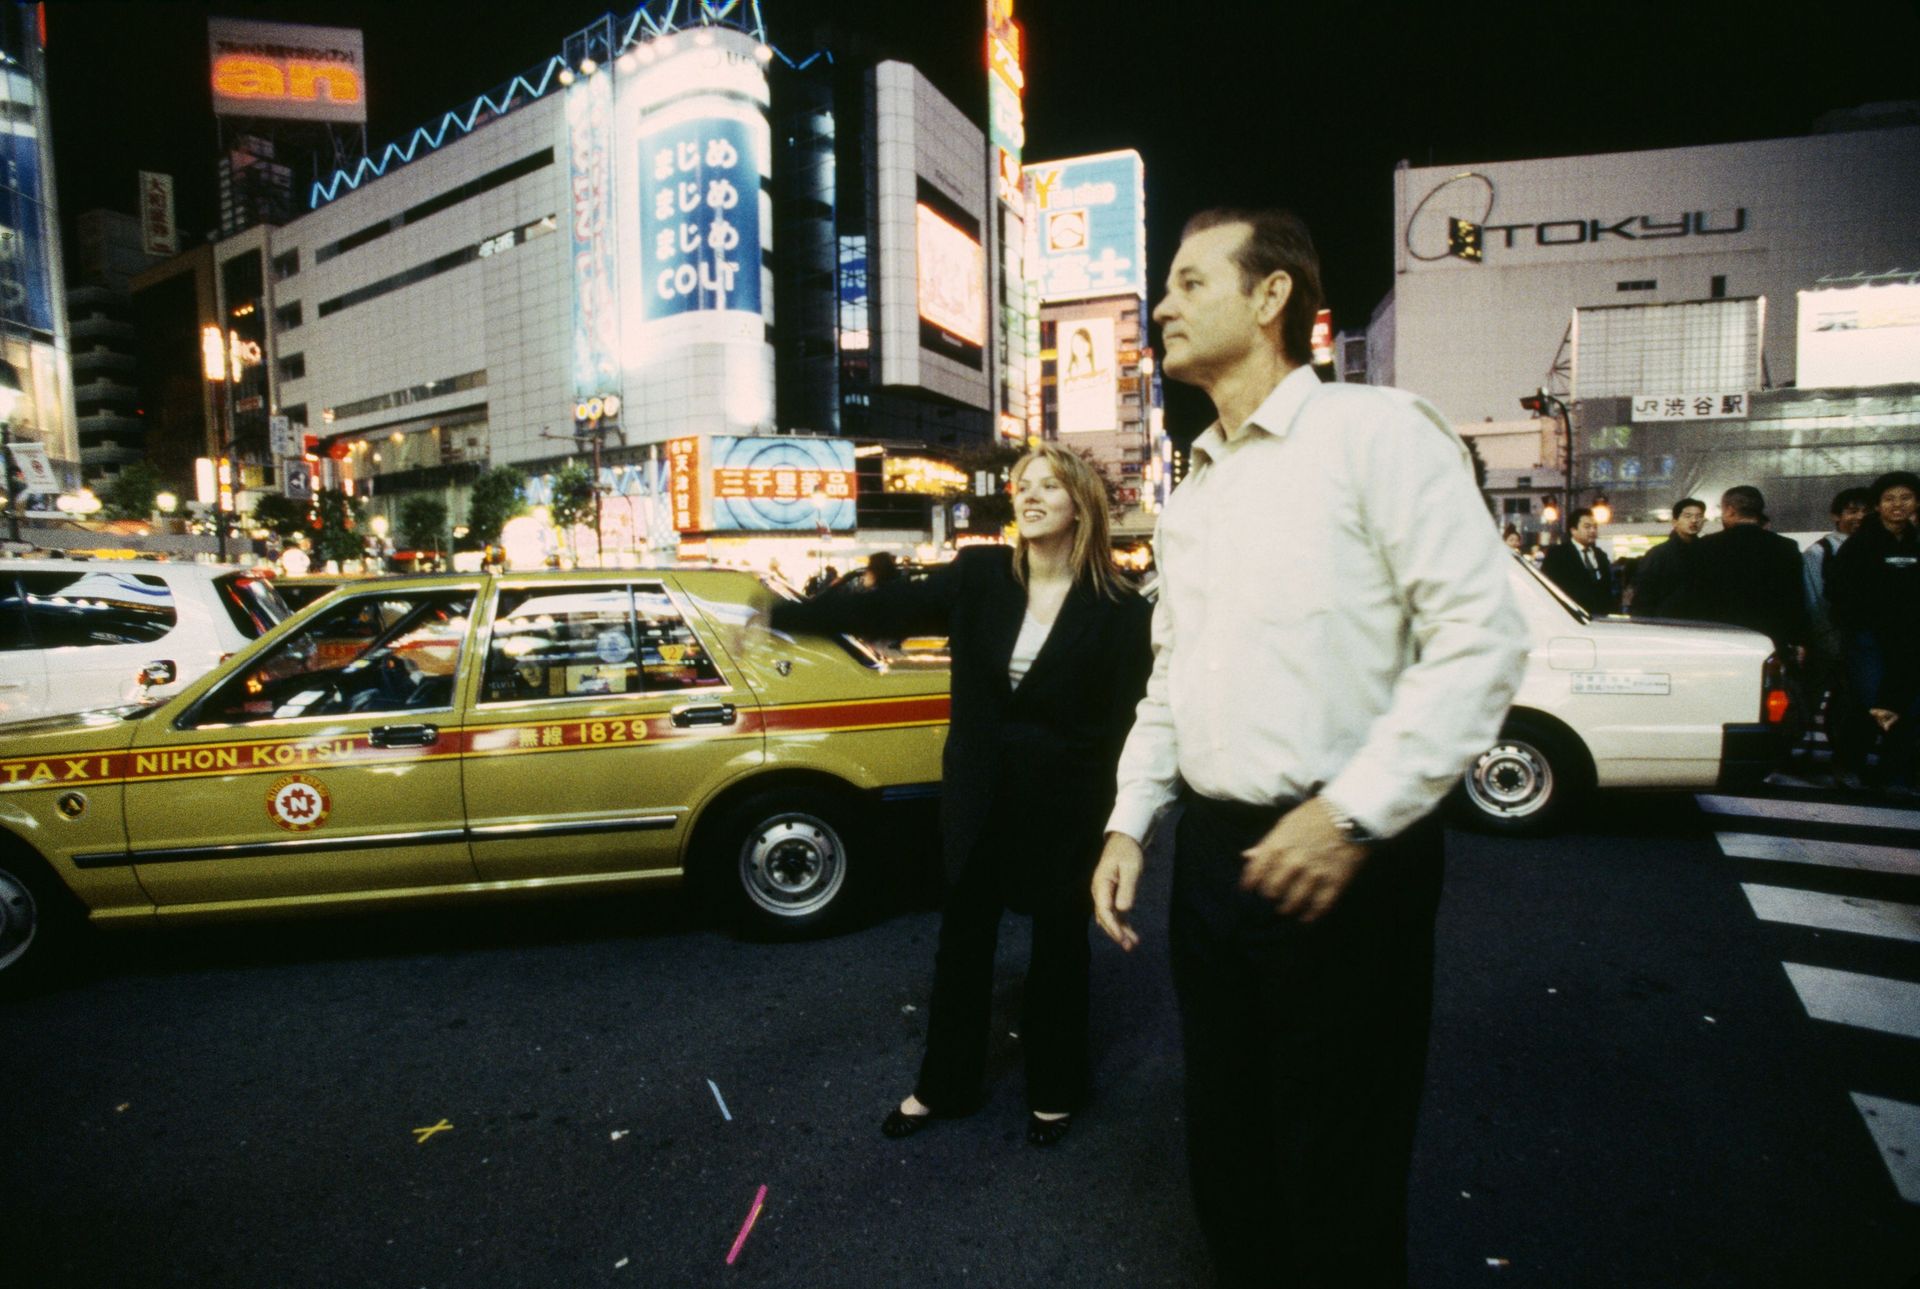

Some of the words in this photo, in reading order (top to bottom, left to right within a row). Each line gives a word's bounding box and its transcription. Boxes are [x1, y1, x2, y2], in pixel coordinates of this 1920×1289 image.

[213, 54, 360, 103] an
[655, 138, 738, 181] まじめ
[656, 179, 739, 221] まじめ
[656, 219, 740, 261] まじめ
[1484, 207, 1746, 248] TOKYU
[657, 261, 740, 300] COLT
[580, 720, 648, 743] 1829
[2, 758, 110, 785] TAXI
[136, 748, 238, 774] NIHON
[252, 741, 355, 766] KOTSU
[290, 796, 308, 812] N
